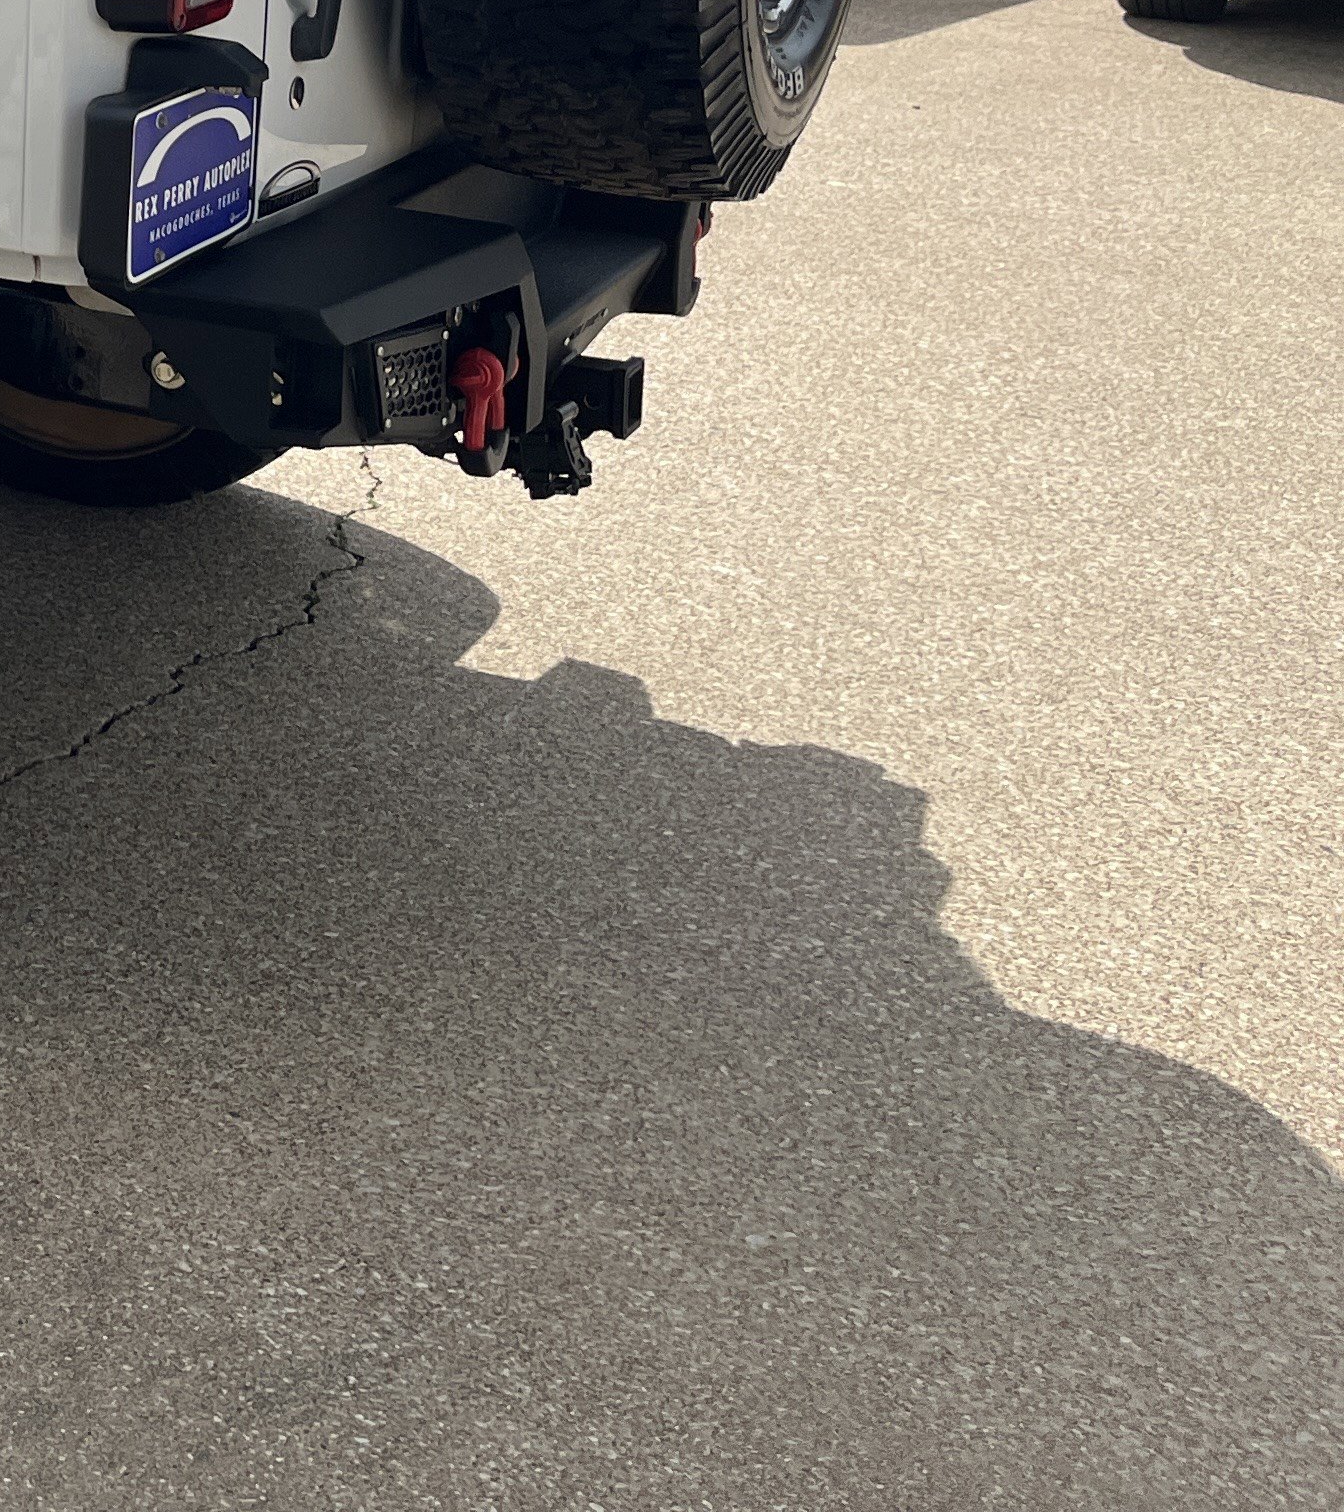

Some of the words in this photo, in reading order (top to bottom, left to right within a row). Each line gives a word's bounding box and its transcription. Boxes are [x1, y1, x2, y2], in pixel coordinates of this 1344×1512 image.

[134, 193, 159, 224] REX
[163, 175, 200, 211] PERRY
[203, 148, 251, 192] AUTOPLEX
[217, 187, 240, 211] TEXAS
